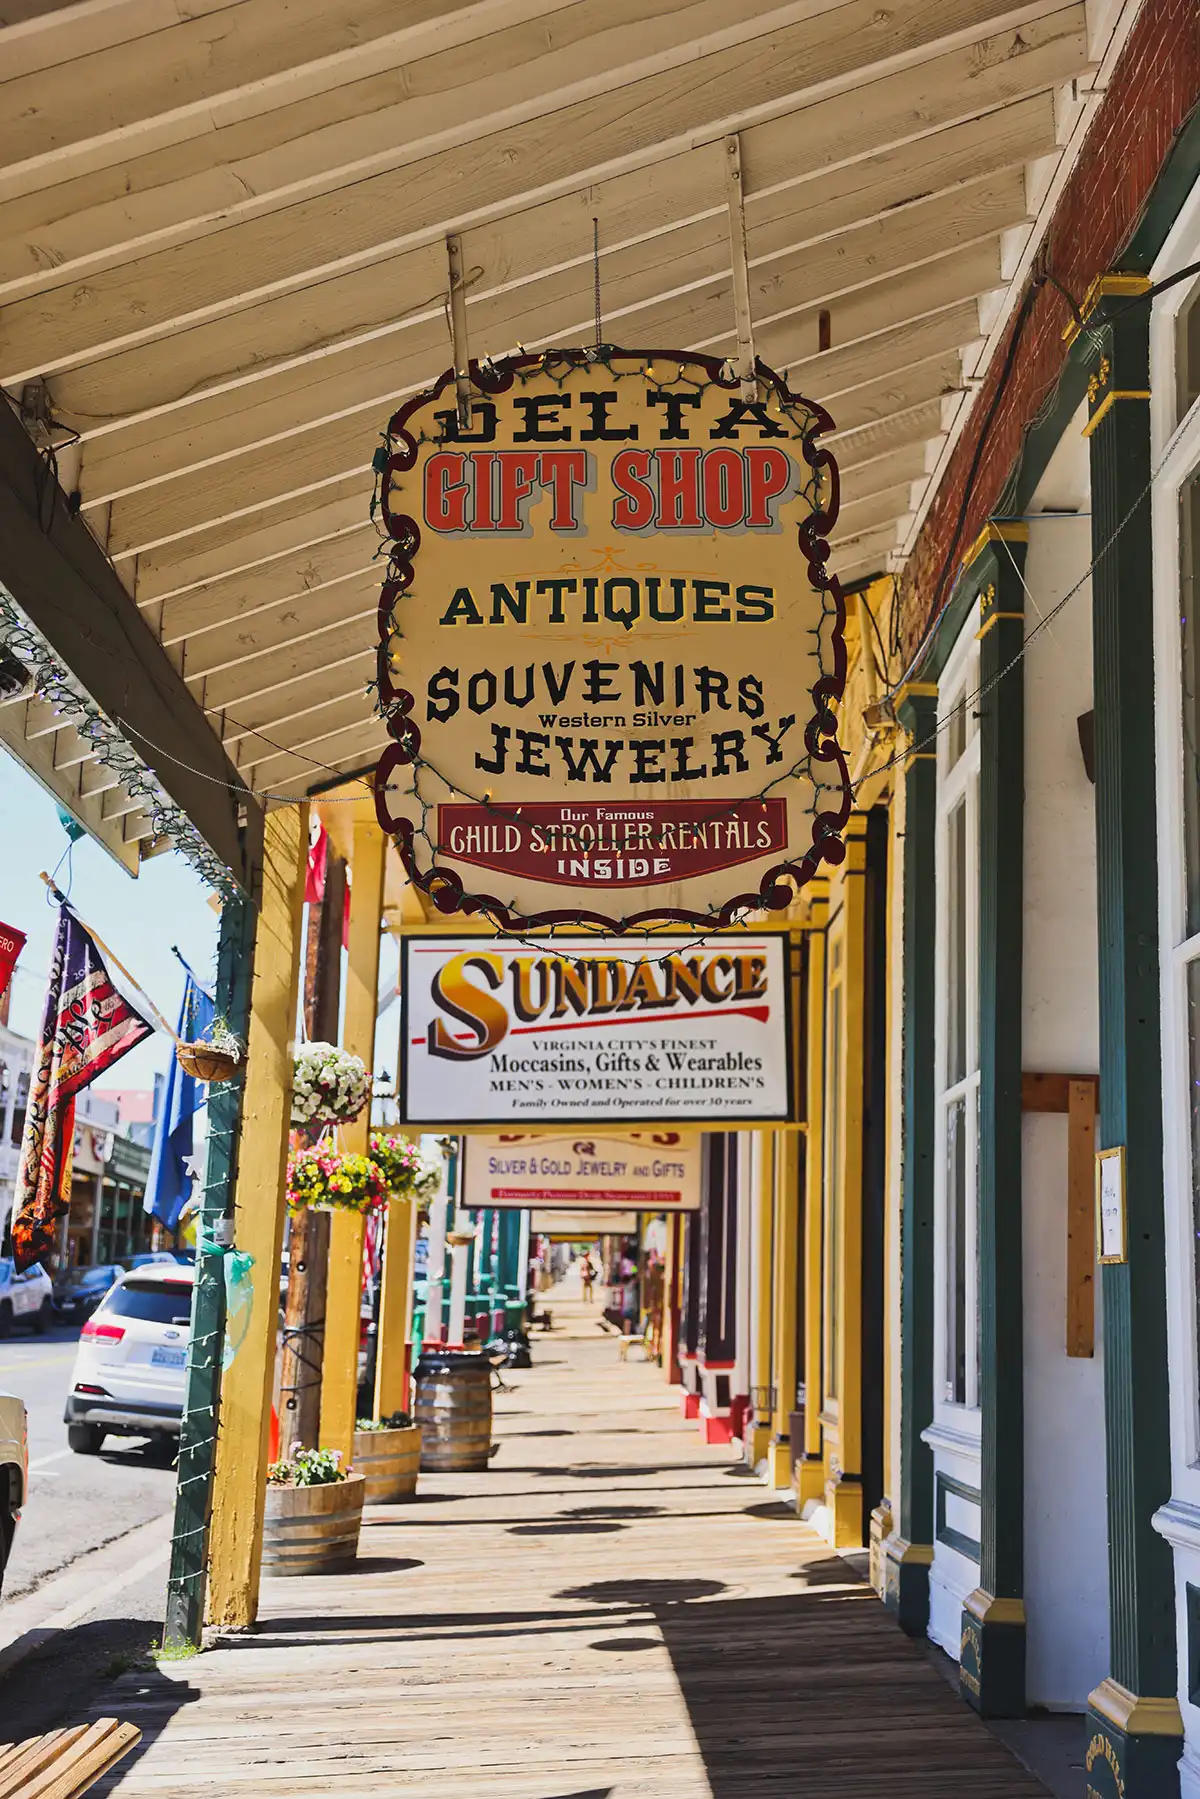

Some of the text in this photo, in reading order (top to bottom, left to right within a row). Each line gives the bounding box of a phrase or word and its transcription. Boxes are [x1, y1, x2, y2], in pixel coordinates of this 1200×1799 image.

[433, 389, 789, 443] DELTA
[423, 446, 793, 534] GIFT SHOP
[439, 577, 775, 631] ANTIQUES
[426, 660, 764, 723] SOUVENIRS
[538, 711, 696, 728] Western Silver
[475, 714, 796, 784] JEWELRY
[561, 808, 654, 821] Our Famous
[450, 820, 772, 853] CHILD STROLLER RENTALS
[557, 857, 671, 880] INSIDE
[428, 951, 768, 1061] SUNDANCE
[532, 1039, 717, 1051] VIRGINIA CITY'S FINEST
[490, 1051, 763, 1075] Moccasins, Gifts & Wearables
[490, 1079, 544, 1092] MEN'S
[558, 1078, 643, 1091] WOMEN'S
[655, 1076, 765, 1089] CHILDREN'S
[512, 1098, 548, 1109] Family
[551, 1097, 589, 1107] Owned
[591, 1097, 610, 1107] and
[612, 1097, 663, 1109] Operated
[664, 1096, 680, 1107] for
[723, 1098, 752, 1108] years
[489, 1157, 527, 1175] SILVER
[529, 1157, 537, 1175] &
[540, 1157, 571, 1176] GOLD
[576, 1160, 627, 1177] JEWELRY
[652, 1159, 685, 1178] GIFTS
